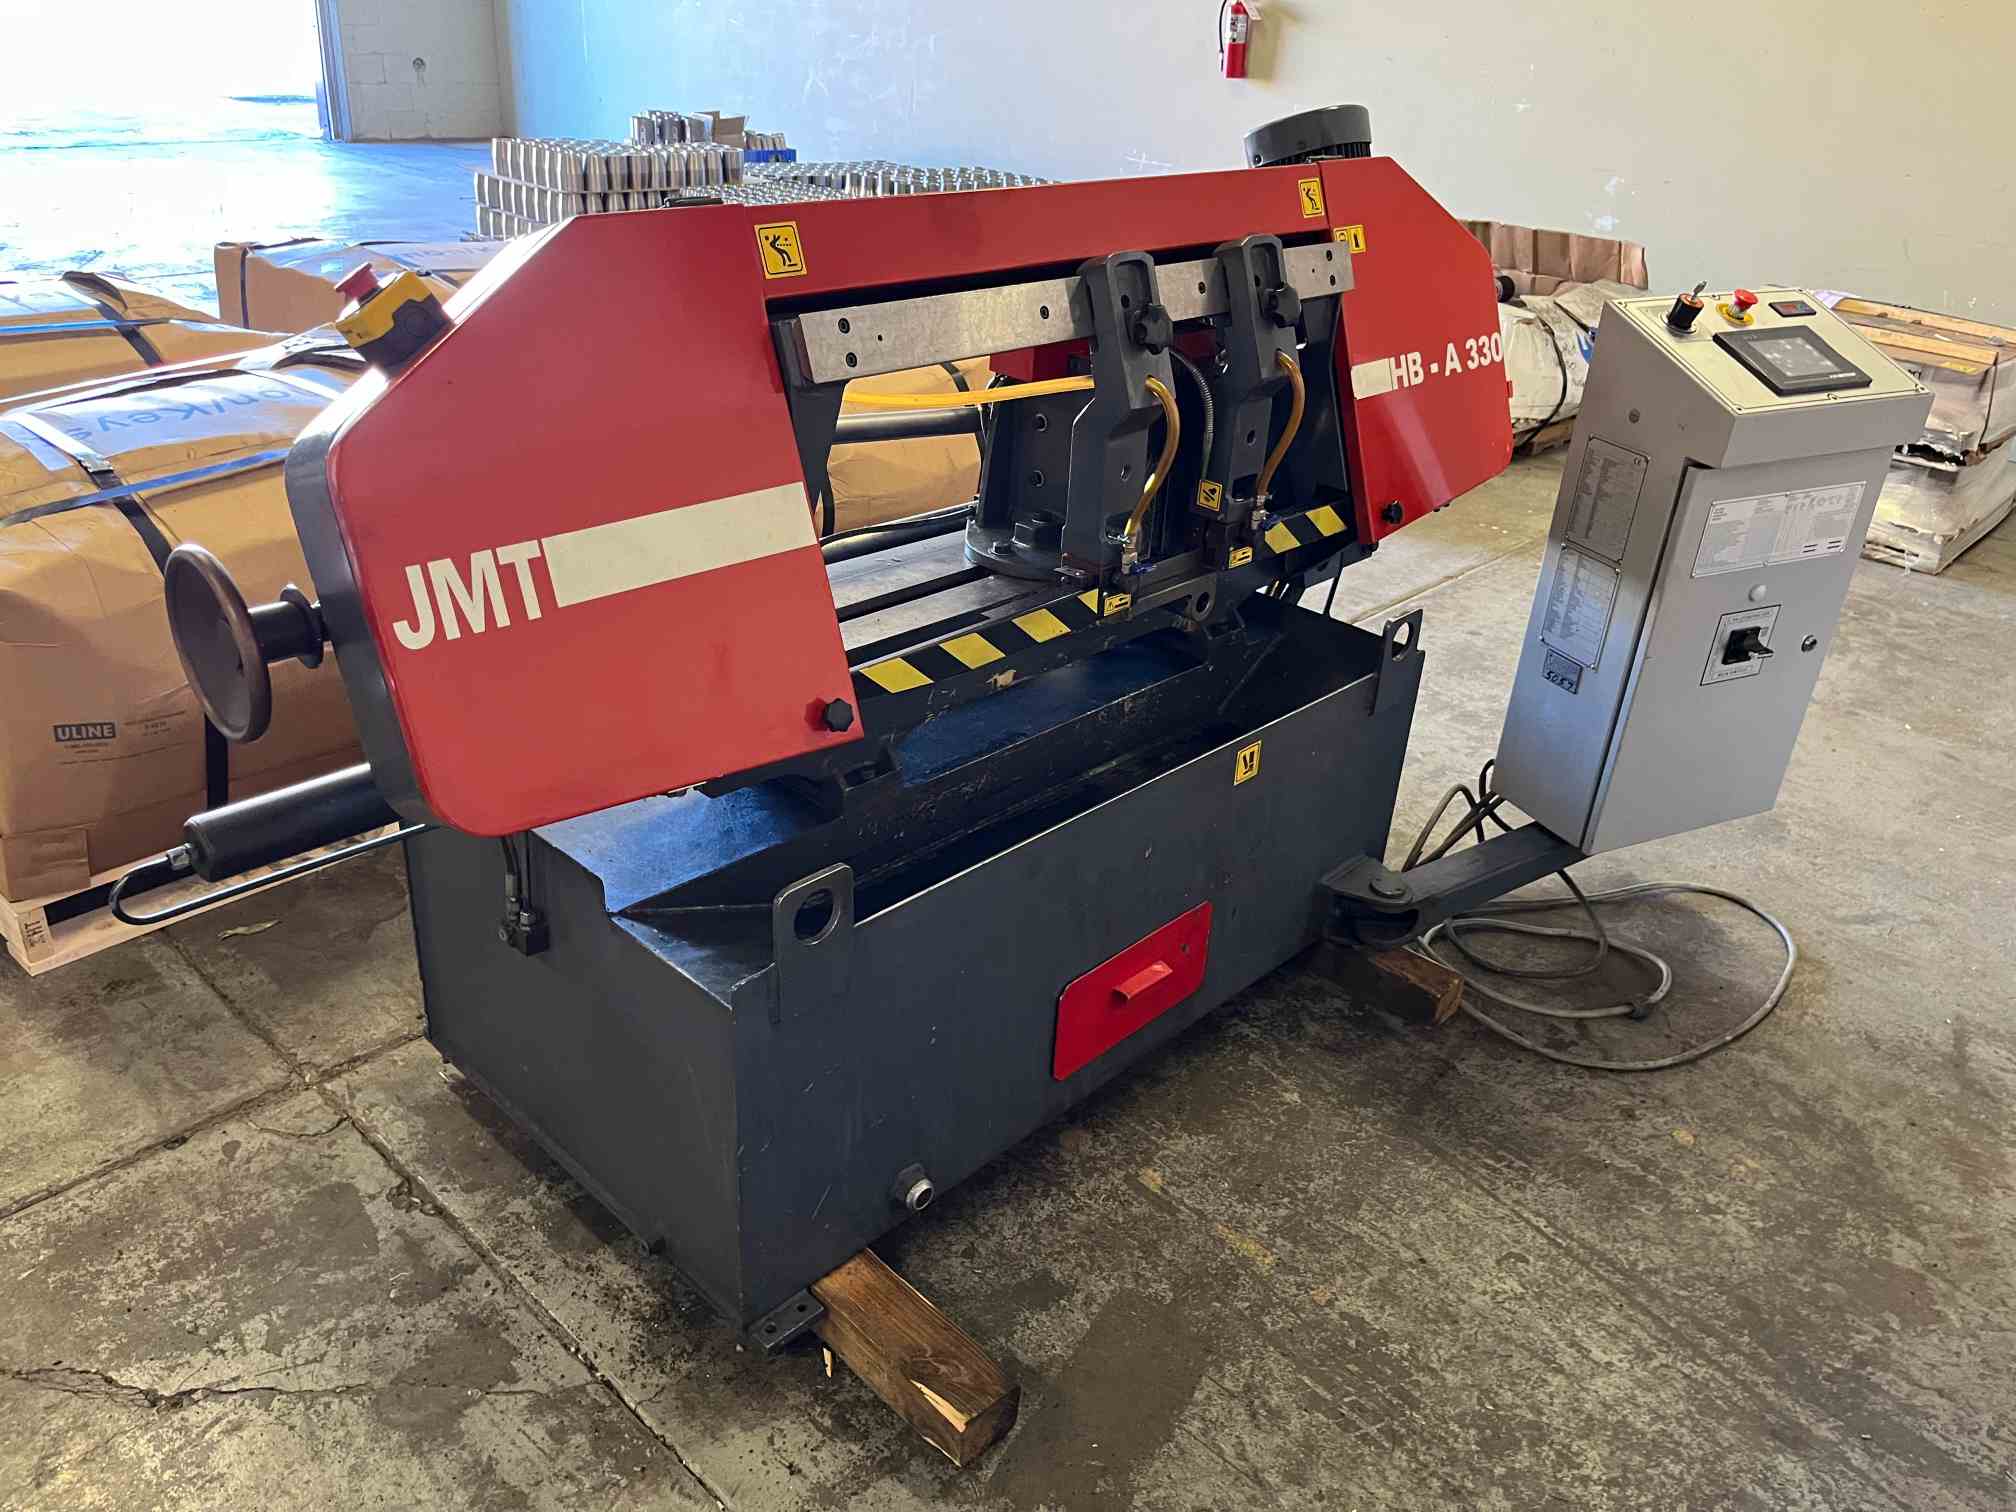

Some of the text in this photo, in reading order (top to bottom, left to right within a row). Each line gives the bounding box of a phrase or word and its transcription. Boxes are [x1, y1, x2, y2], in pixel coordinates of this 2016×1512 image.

[1389, 352, 1424, 390] HB
[1445, 342, 1462, 376] A
[1466, 332, 1503, 370] 330
[392, 539, 542, 650] JMT
[56, 724, 114, 741] ULINE
